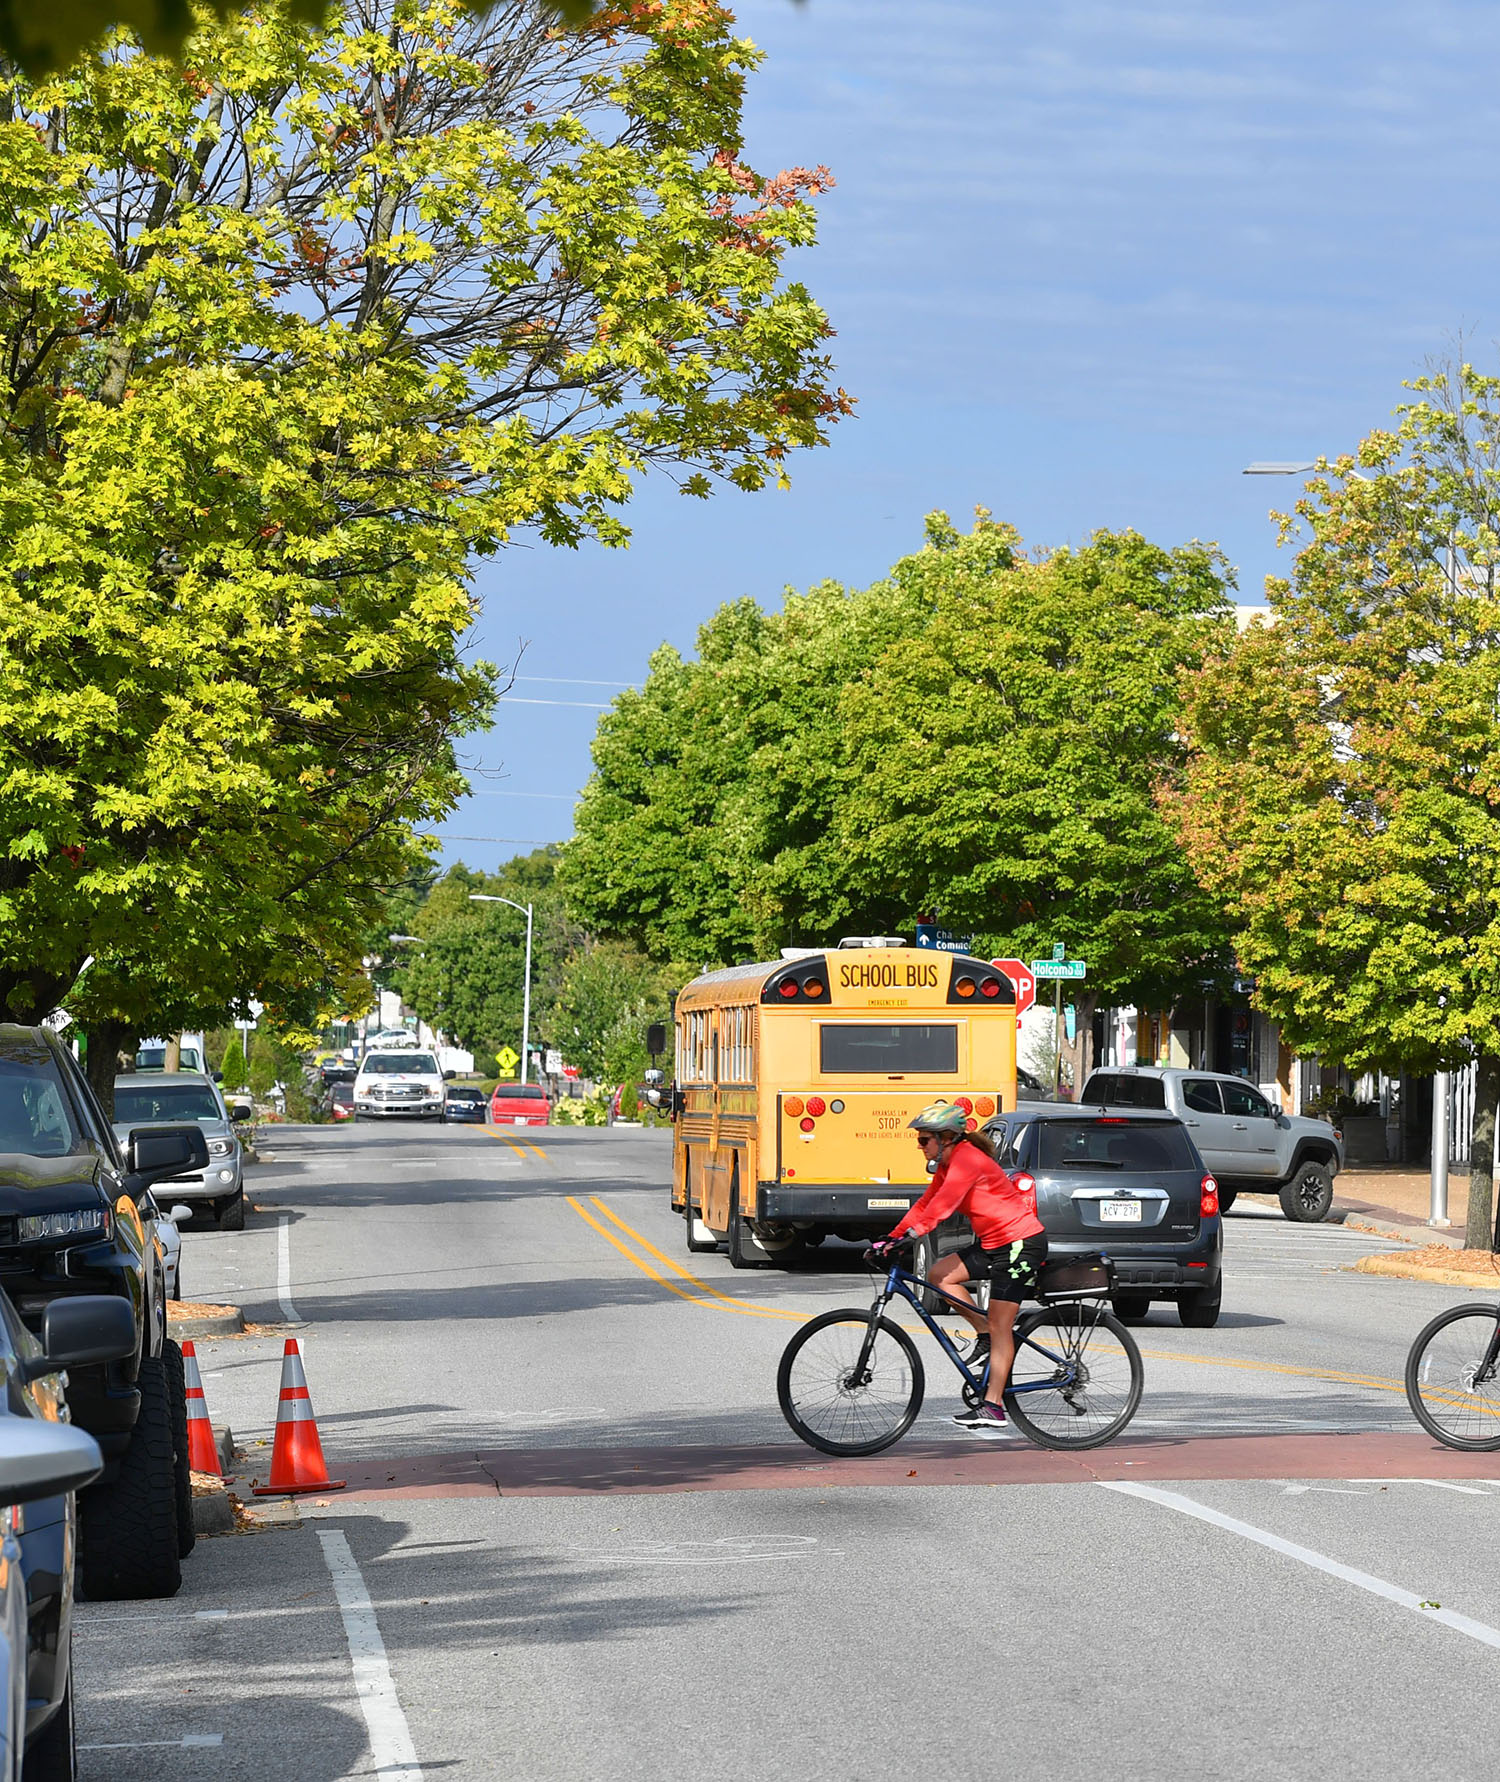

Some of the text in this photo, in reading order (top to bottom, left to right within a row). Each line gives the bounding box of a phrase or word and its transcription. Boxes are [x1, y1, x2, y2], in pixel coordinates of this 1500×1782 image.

[1033, 963, 1074, 976] Holcomb
[840, 964, 938, 988] SCHOOL BUS
[879, 1117, 901, 1129] STOP
[1103, 1206, 1139, 1217] ACV 27P
